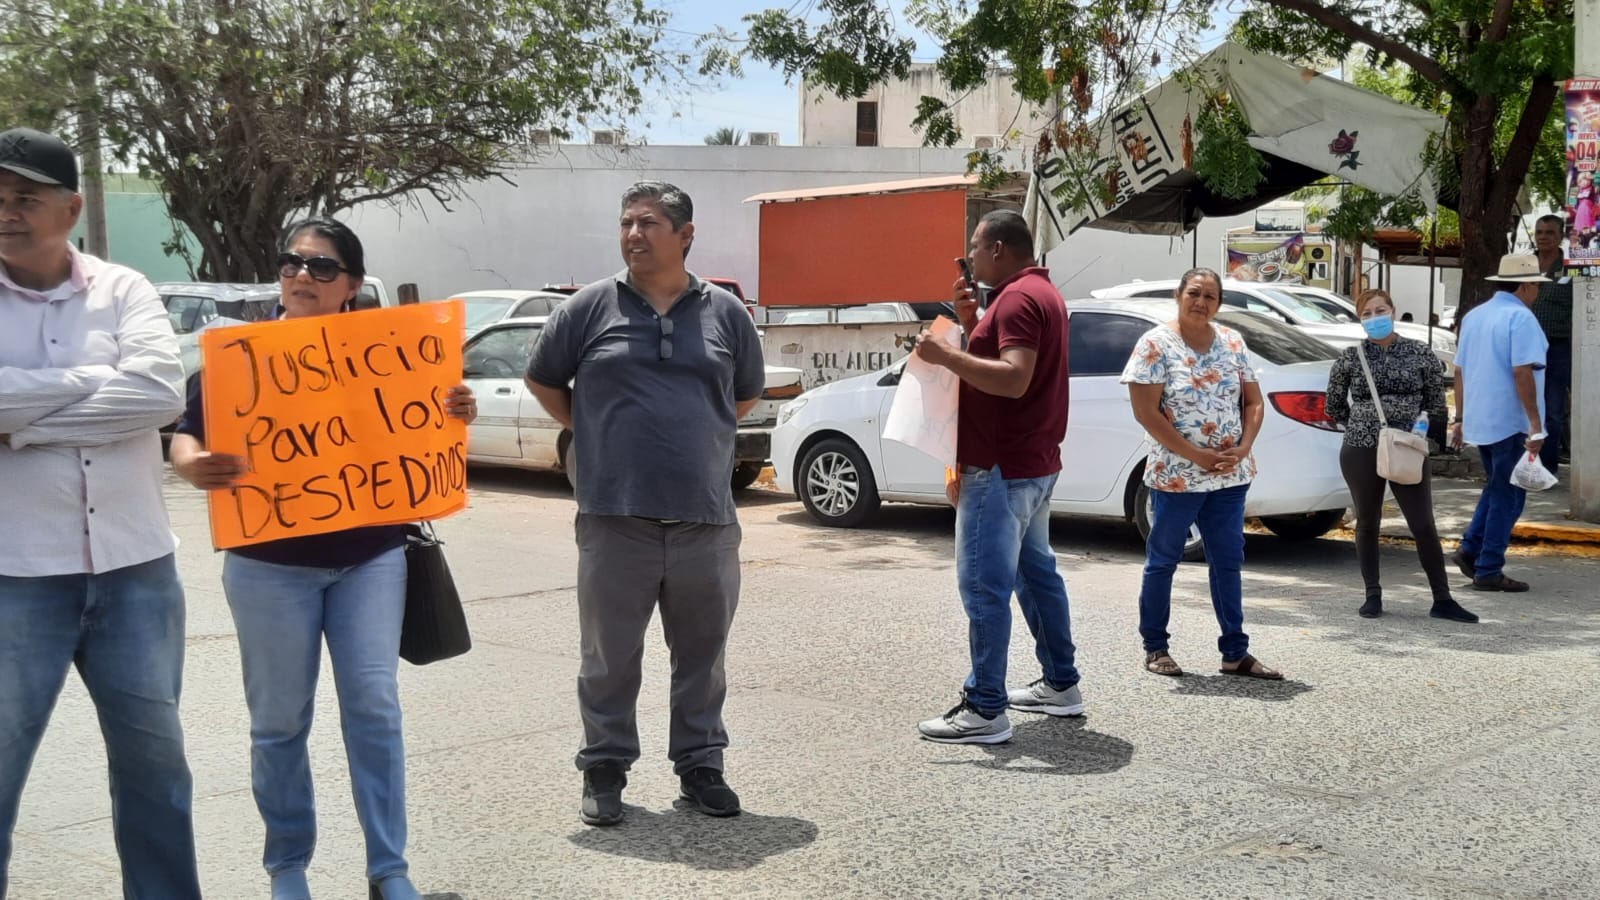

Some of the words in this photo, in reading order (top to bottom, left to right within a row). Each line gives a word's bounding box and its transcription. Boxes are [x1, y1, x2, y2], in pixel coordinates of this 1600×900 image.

[1577, 141, 1597, 161] 04
[813, 352, 839, 369] DEL
[374, 385, 445, 434] los
